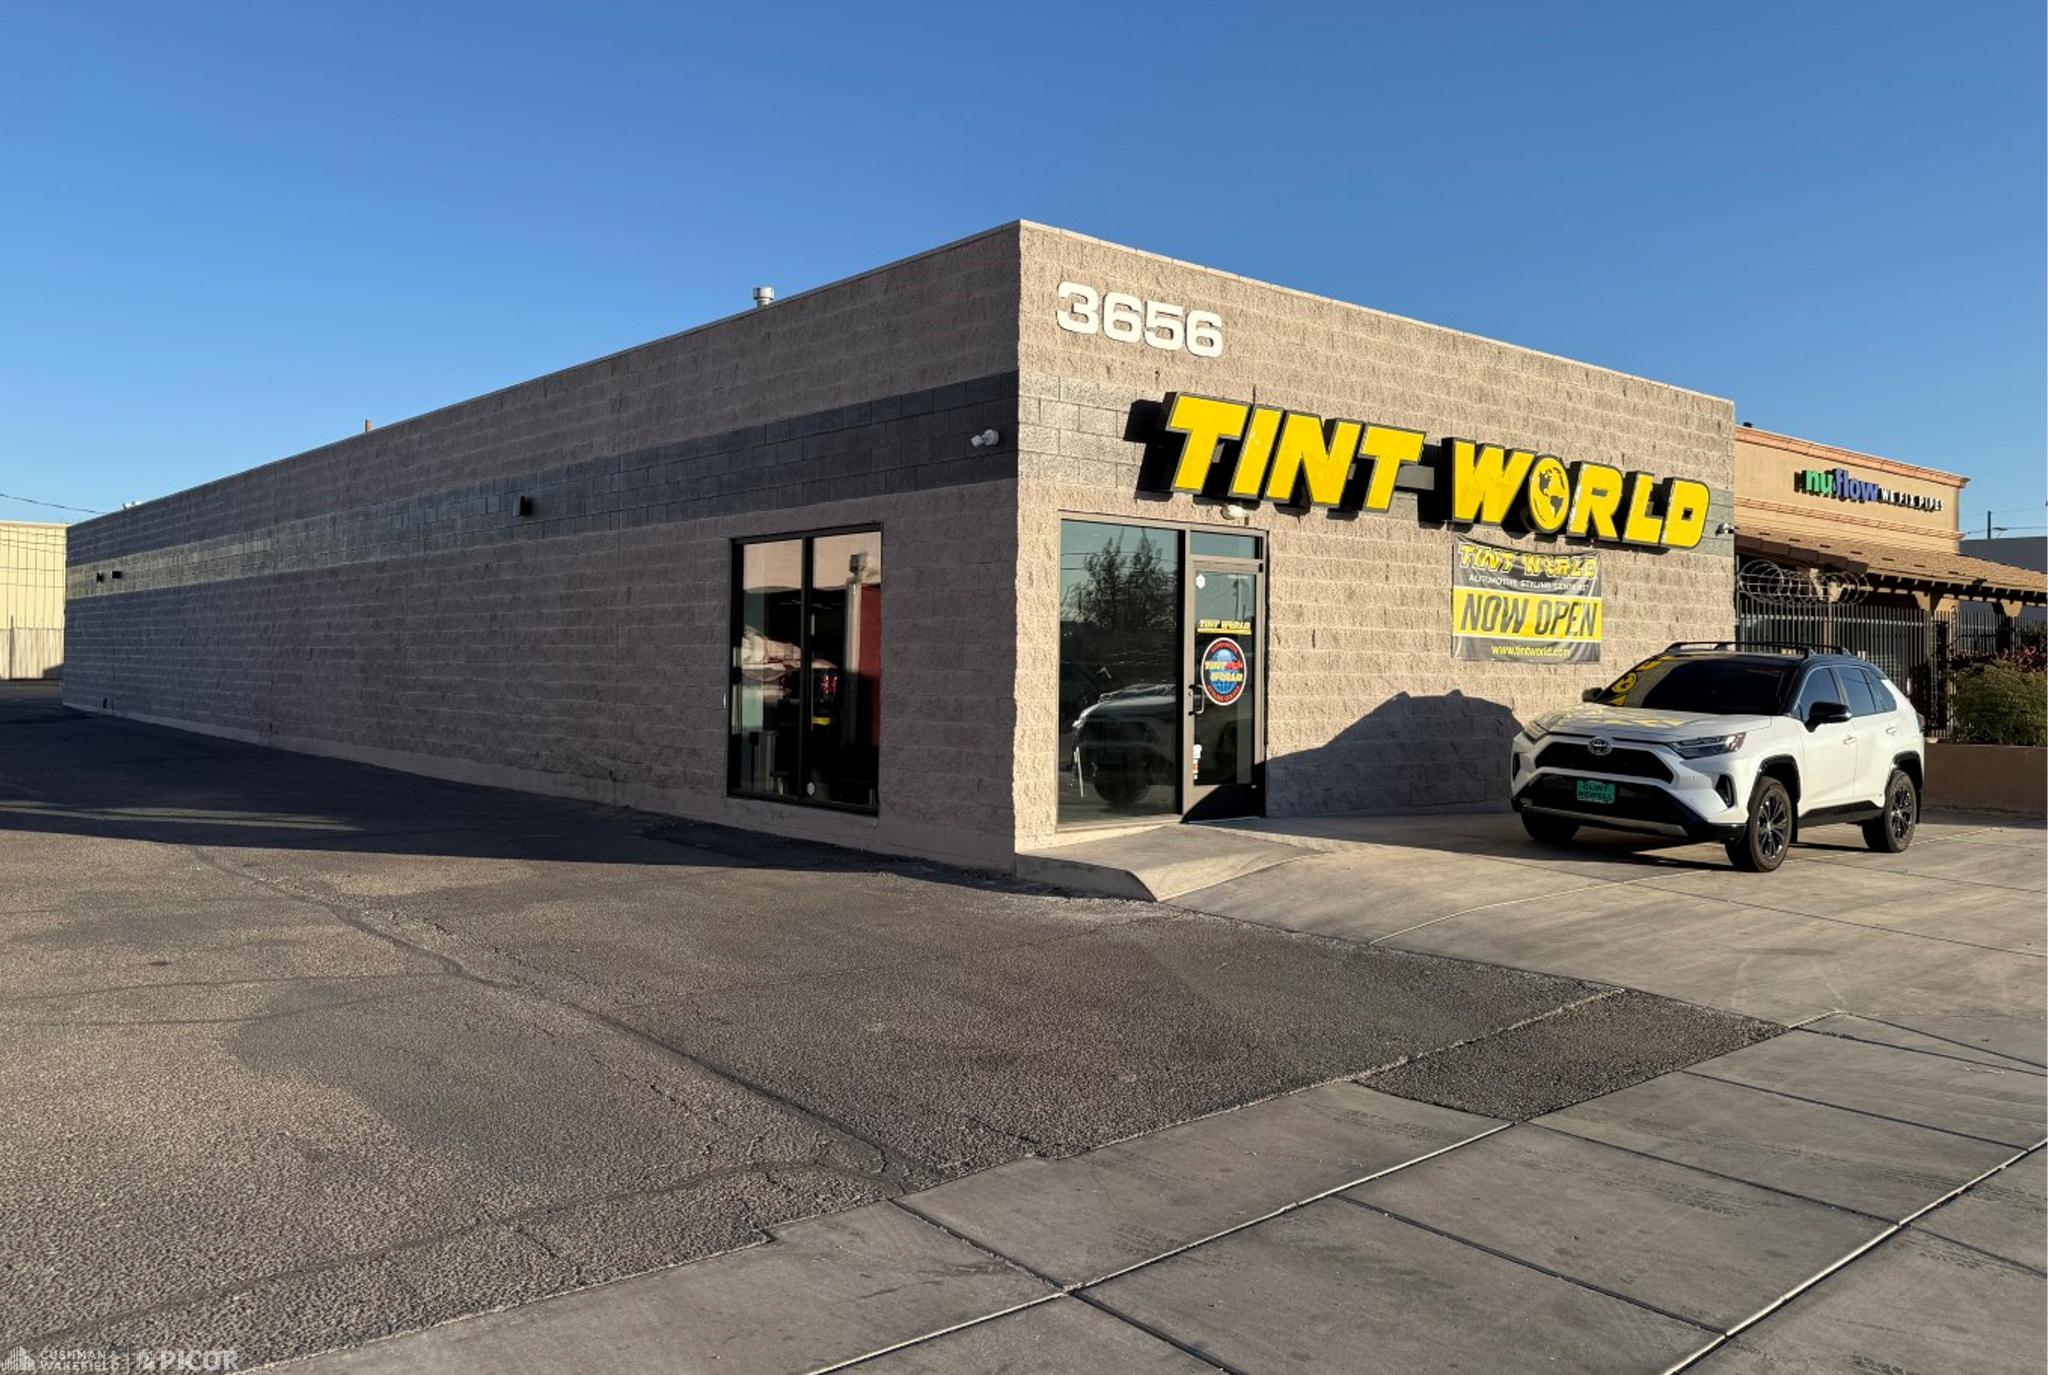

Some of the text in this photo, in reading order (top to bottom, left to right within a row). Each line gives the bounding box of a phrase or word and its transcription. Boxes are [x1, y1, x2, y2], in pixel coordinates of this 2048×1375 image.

[1056, 281, 1223, 358] 3656
[1165, 391, 1711, 549] TINT WORLD
[1881, 487, 1946, 511] WE FIX PIPES
[1458, 542, 1598, 580] TINT WORLD
[1468, 573, 1518, 588] AUTOMOTIVE
[1460, 593, 1598, 637] NOW OPEN
[1491, 644, 1571, 658] www.tintworld.com
